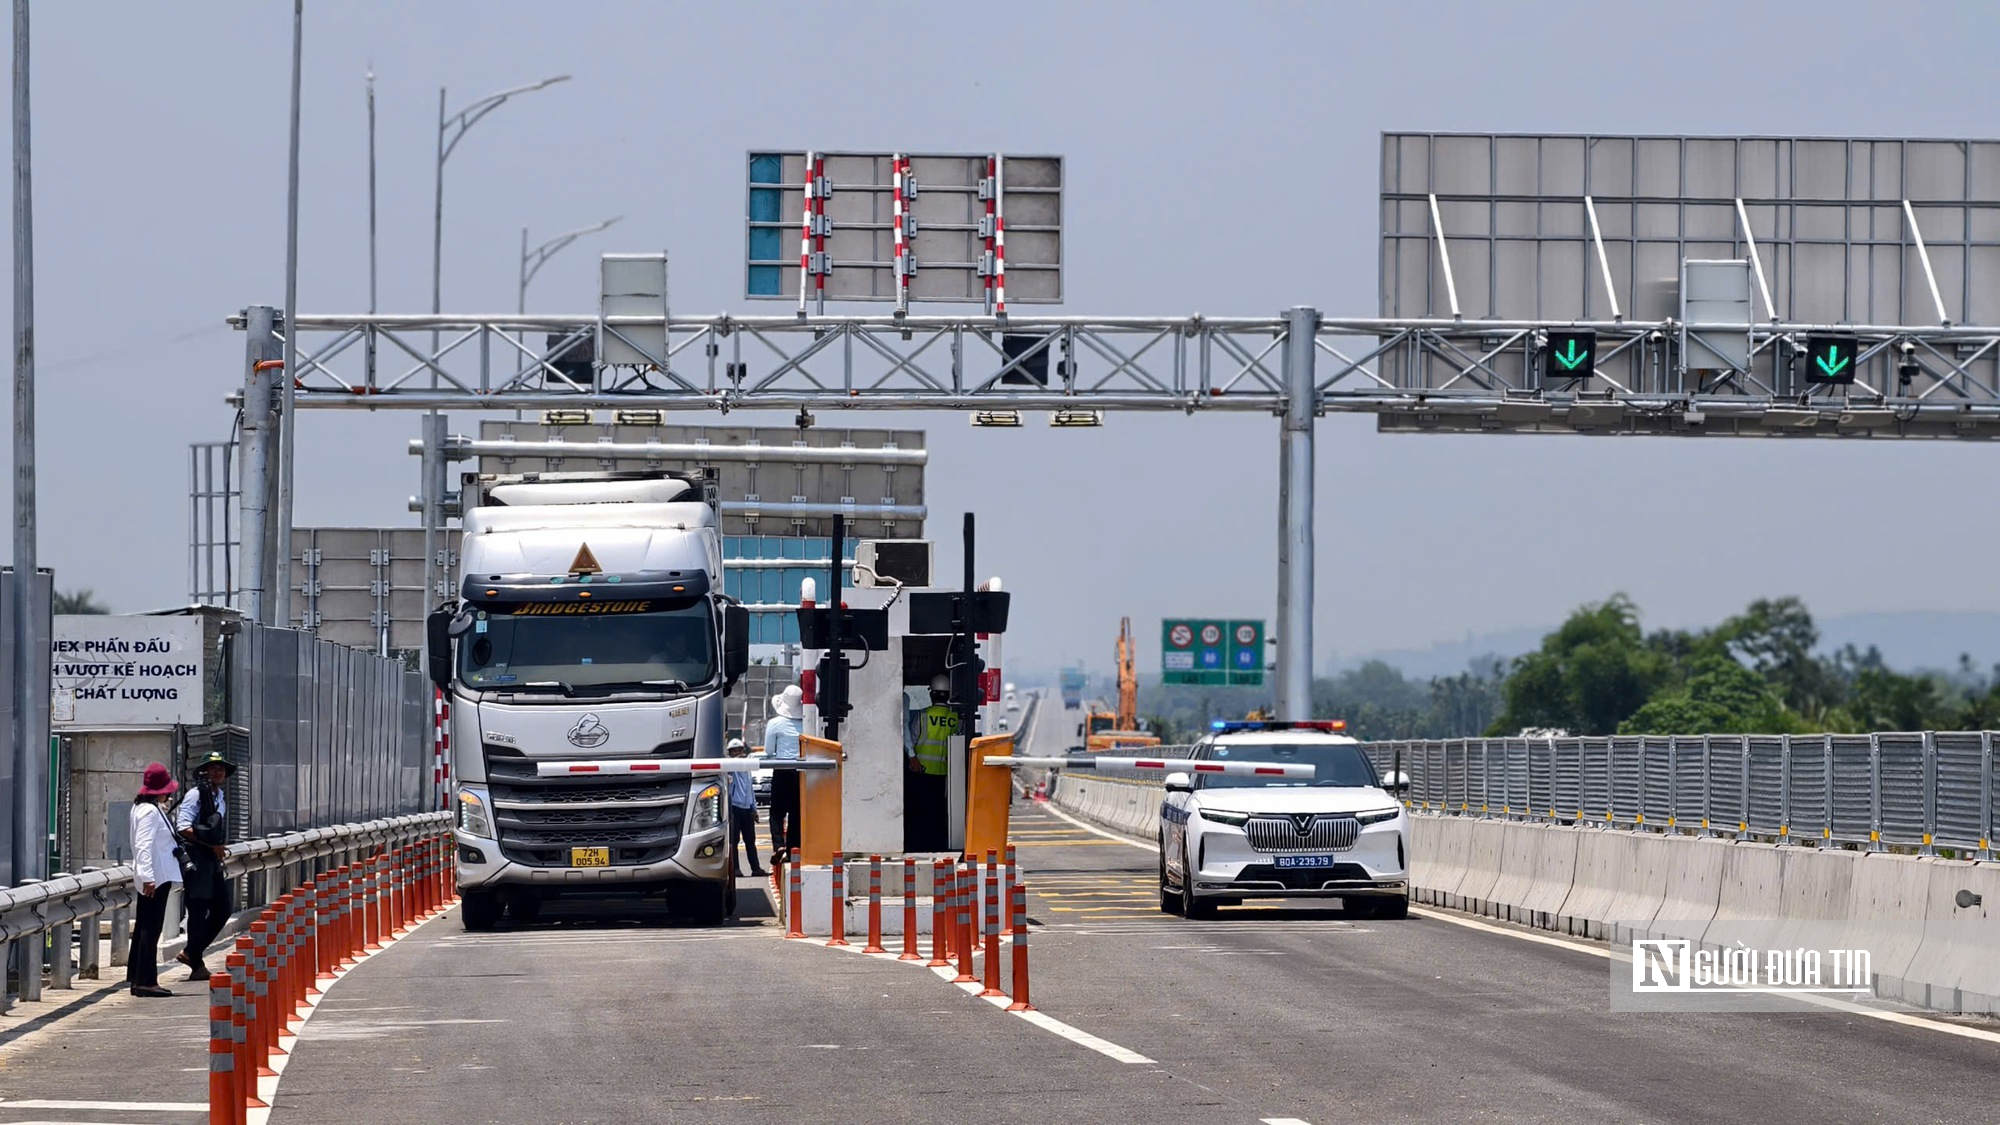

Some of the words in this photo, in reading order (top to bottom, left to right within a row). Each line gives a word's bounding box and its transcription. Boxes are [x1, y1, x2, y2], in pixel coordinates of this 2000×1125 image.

[512, 600, 651, 615] BRIDGESTONE
[85, 637, 129, 652] PHẤN
[133, 637, 170, 652] ĐẤU
[65, 664, 109, 678] VƯỢT
[114, 661, 136, 676] KẾ
[140, 665, 196, 678] HOẠCH
[75, 684, 117, 699] CHẤT
[122, 688, 177, 701] LƯỢNG
[929, 715, 957, 728] VEC
[582, 849, 599, 857] 72H
[576, 858, 605, 866] 005.94
